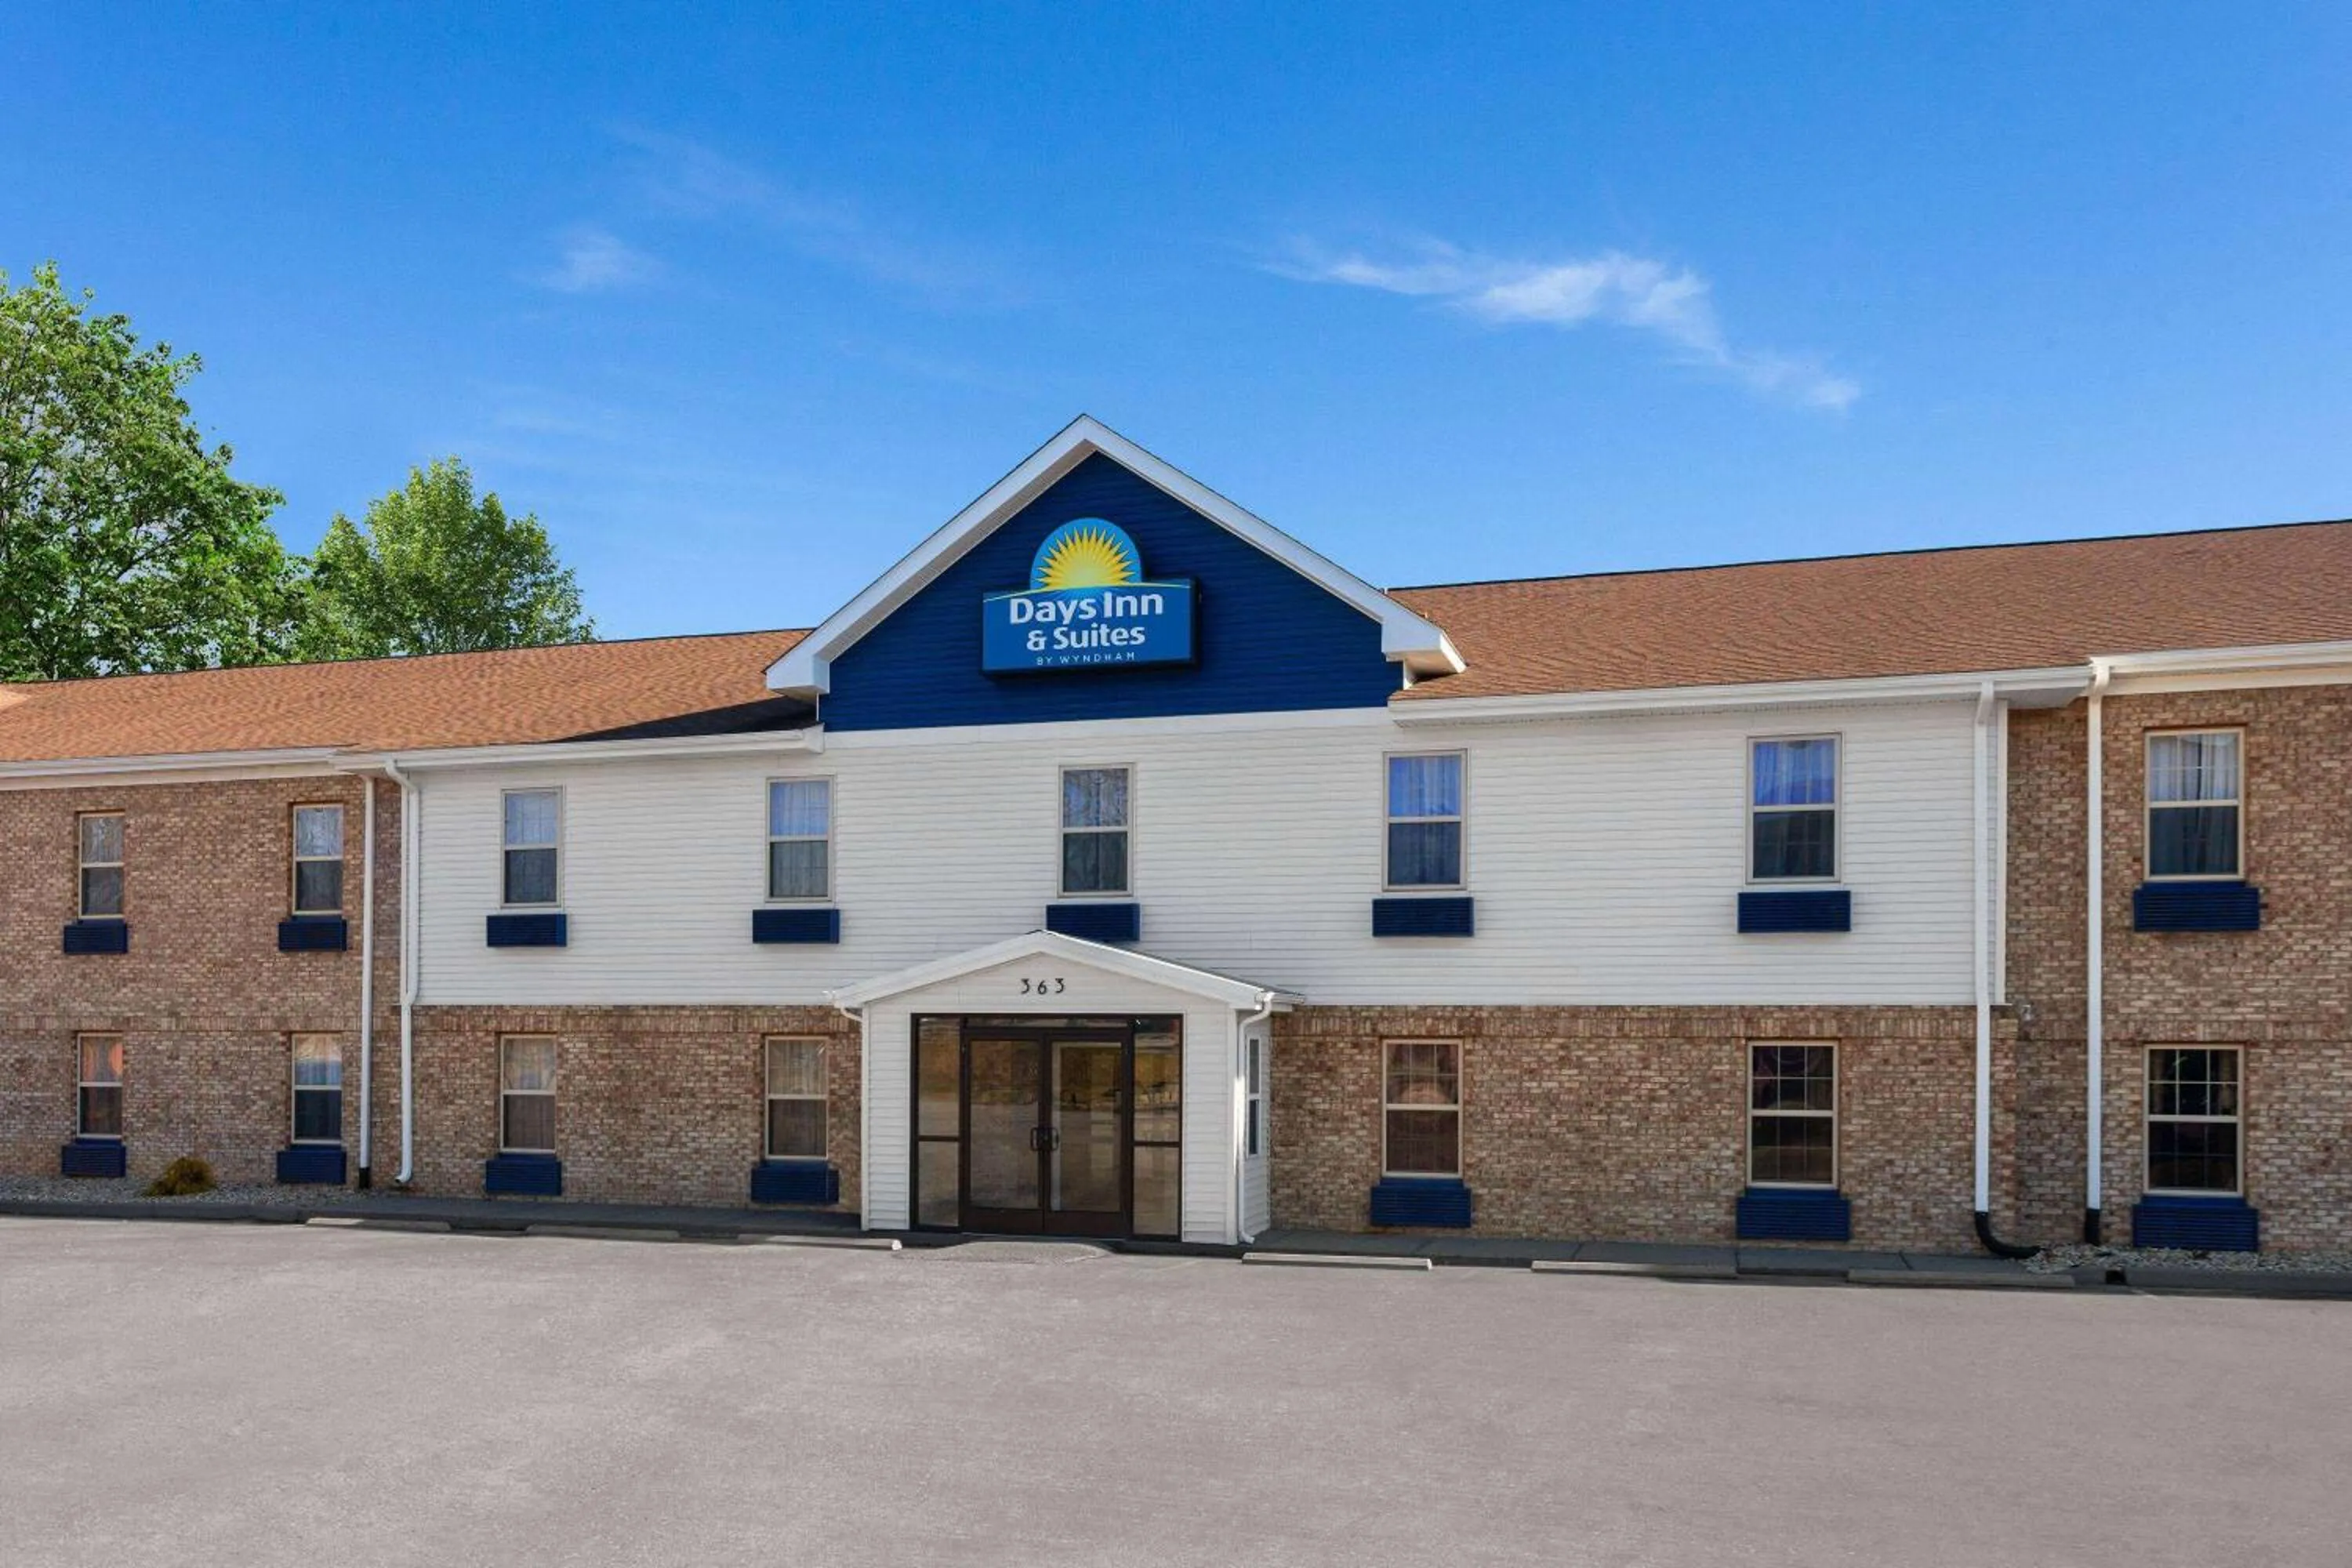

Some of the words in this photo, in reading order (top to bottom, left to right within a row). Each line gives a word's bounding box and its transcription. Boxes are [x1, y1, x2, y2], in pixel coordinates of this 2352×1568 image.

[1026, 630, 1047, 652] &
[1053, 622, 1145, 650] Suites
[1036, 655, 1053, 666] BY
[1059, 652, 1135, 665] WYNDHAM
[1021, 978, 1064, 995] 363
